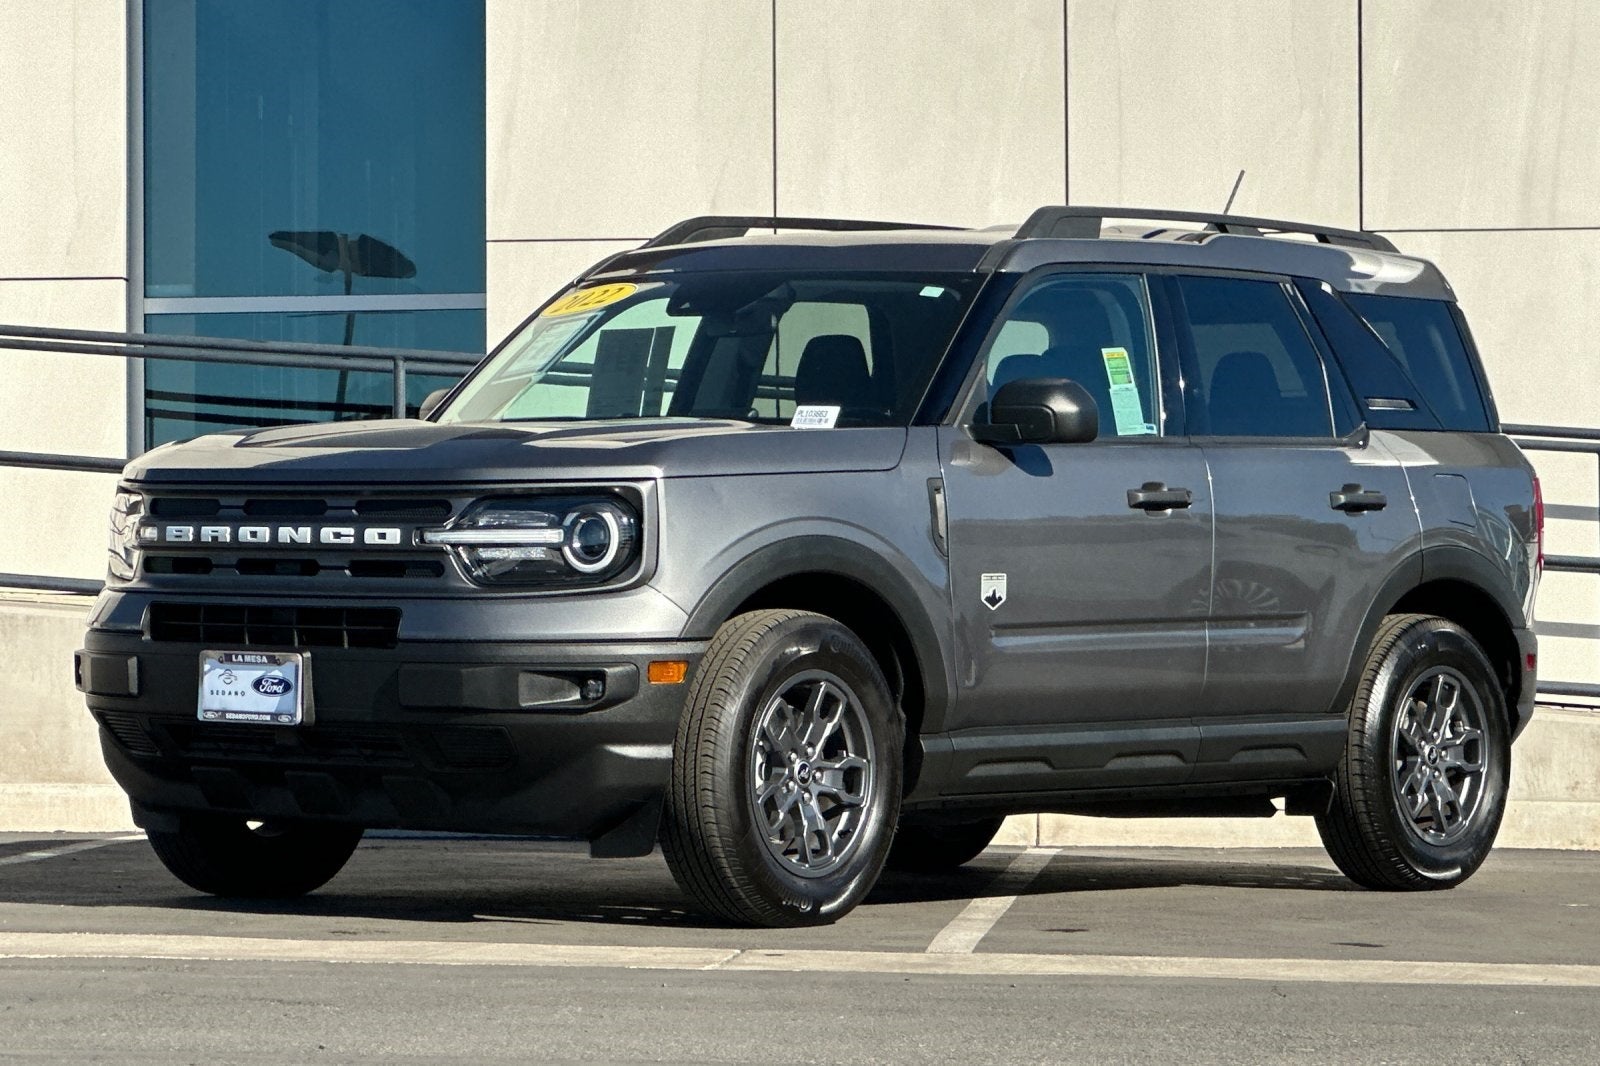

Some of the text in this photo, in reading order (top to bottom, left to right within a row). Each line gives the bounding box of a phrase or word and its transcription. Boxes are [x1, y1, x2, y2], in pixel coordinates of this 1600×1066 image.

[549, 286, 626, 314] 2022
[165, 525, 401, 545] BRONCO
[232, 654, 268, 663] LA MESA
[210, 689, 246, 697] SEDANO
[259, 678, 285, 694] Ford
